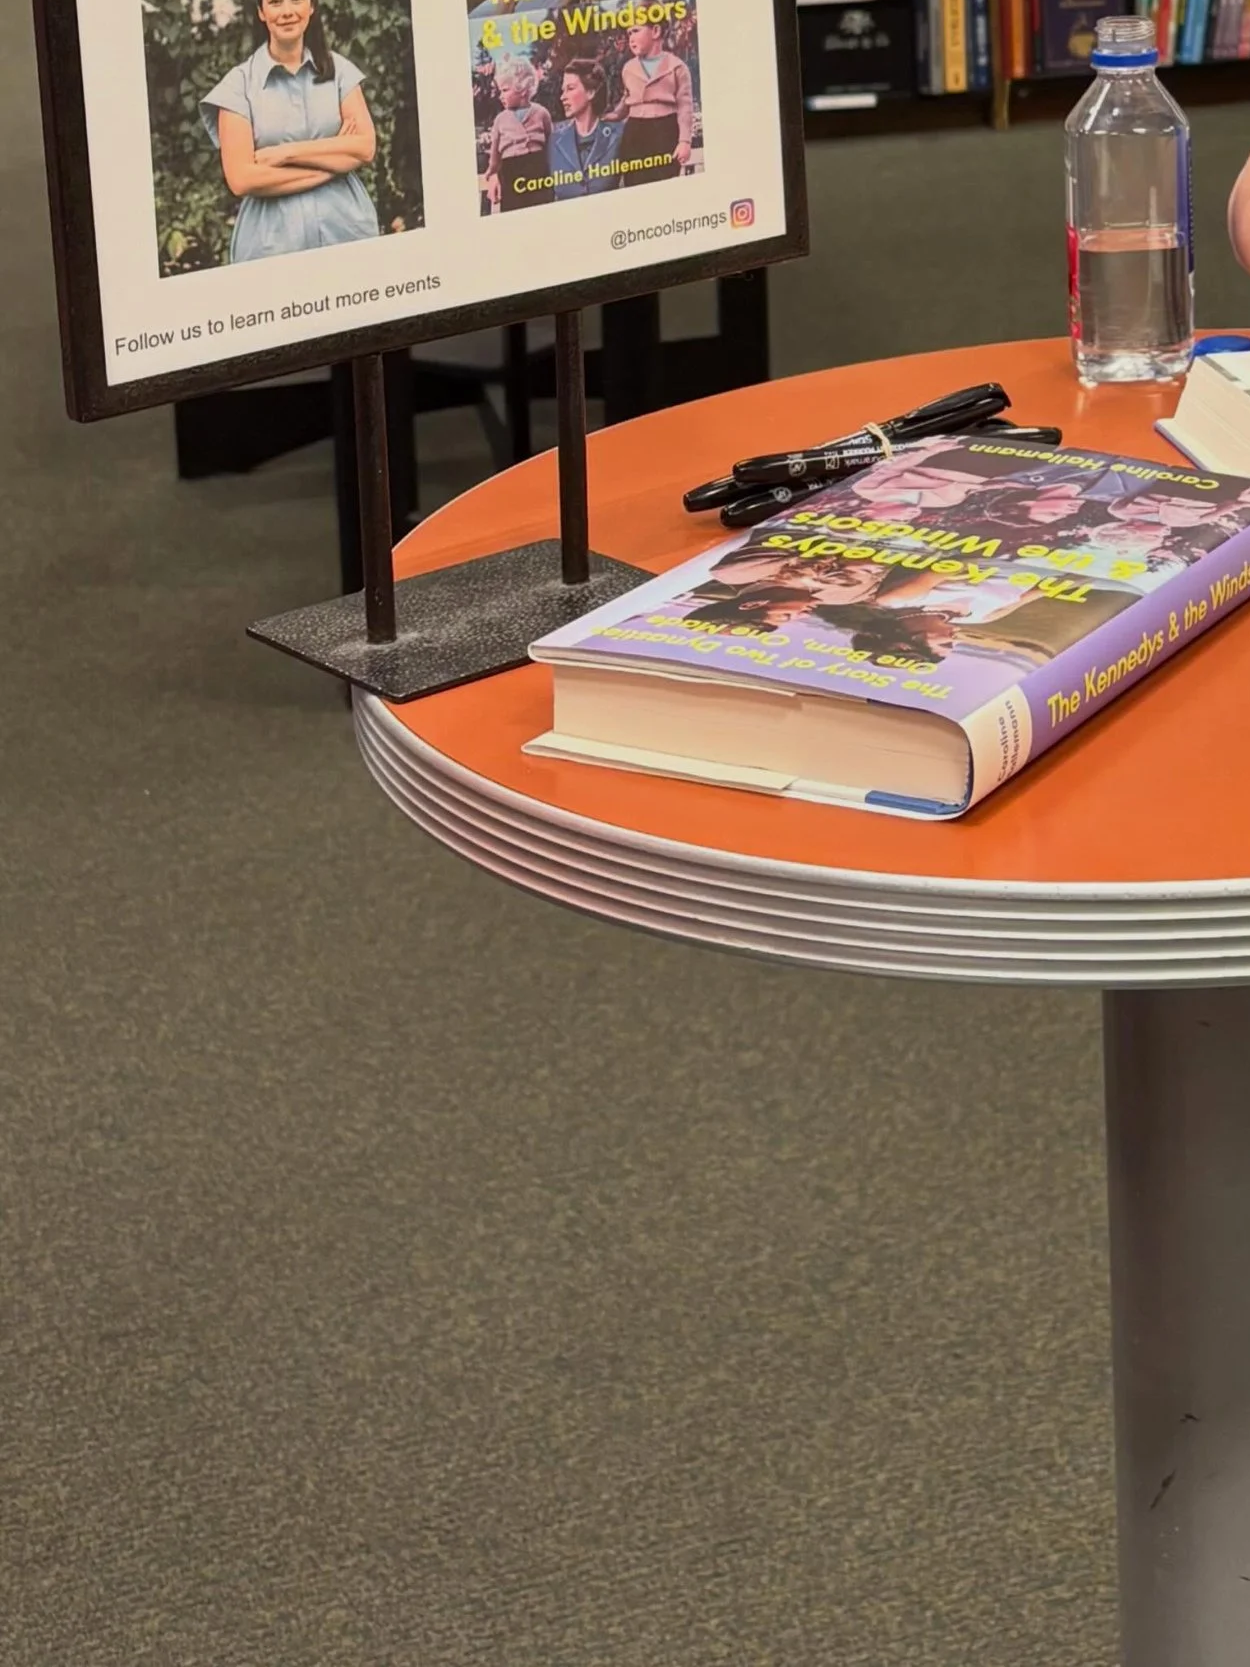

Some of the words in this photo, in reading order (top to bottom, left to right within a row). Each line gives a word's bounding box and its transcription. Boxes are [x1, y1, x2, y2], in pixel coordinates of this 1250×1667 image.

[482, 19, 504, 49] &
[511, 16, 557, 46] the
[562, 0, 687, 36] Windsors
[513, 168, 583, 194] Caroline
[587, 152, 673, 180] Hallemann
[611, 210, 728, 250] @bncoolsprings
[115, 332, 175, 356] Follow
[180, 326, 202, 341] us
[208, 319, 225, 336] to
[230, 308, 275, 330] learn
[280, 295, 332, 320] about
[335, 289, 380, 309] more
[384, 274, 441, 299] events
[968, 443, 1107, 471] Hallemann
[1119, 462, 1221, 490] Caroline
[787, 510, 1002, 559] Windsors
[763, 533, 1000, 585] Kennedys
[1017, 543, 1096, 572] the
[1108, 558, 1149, 580] &
[1007, 571, 1091, 604] The
[646, 615, 729, 635] Made
[730, 626, 791, 647] One
[725, 645, 779, 667] Two
[777, 655, 817, 670] of
[803, 638, 874, 663] Born,
[876, 654, 939, 675] One
[1047, 689, 1081, 728] The
[1084, 629, 1165, 704] Kennedys
[1168, 610, 1181, 643] &
[1183, 599, 1208, 632] the
[826, 664, 896, 689] Story
[901, 679, 954, 701] The
